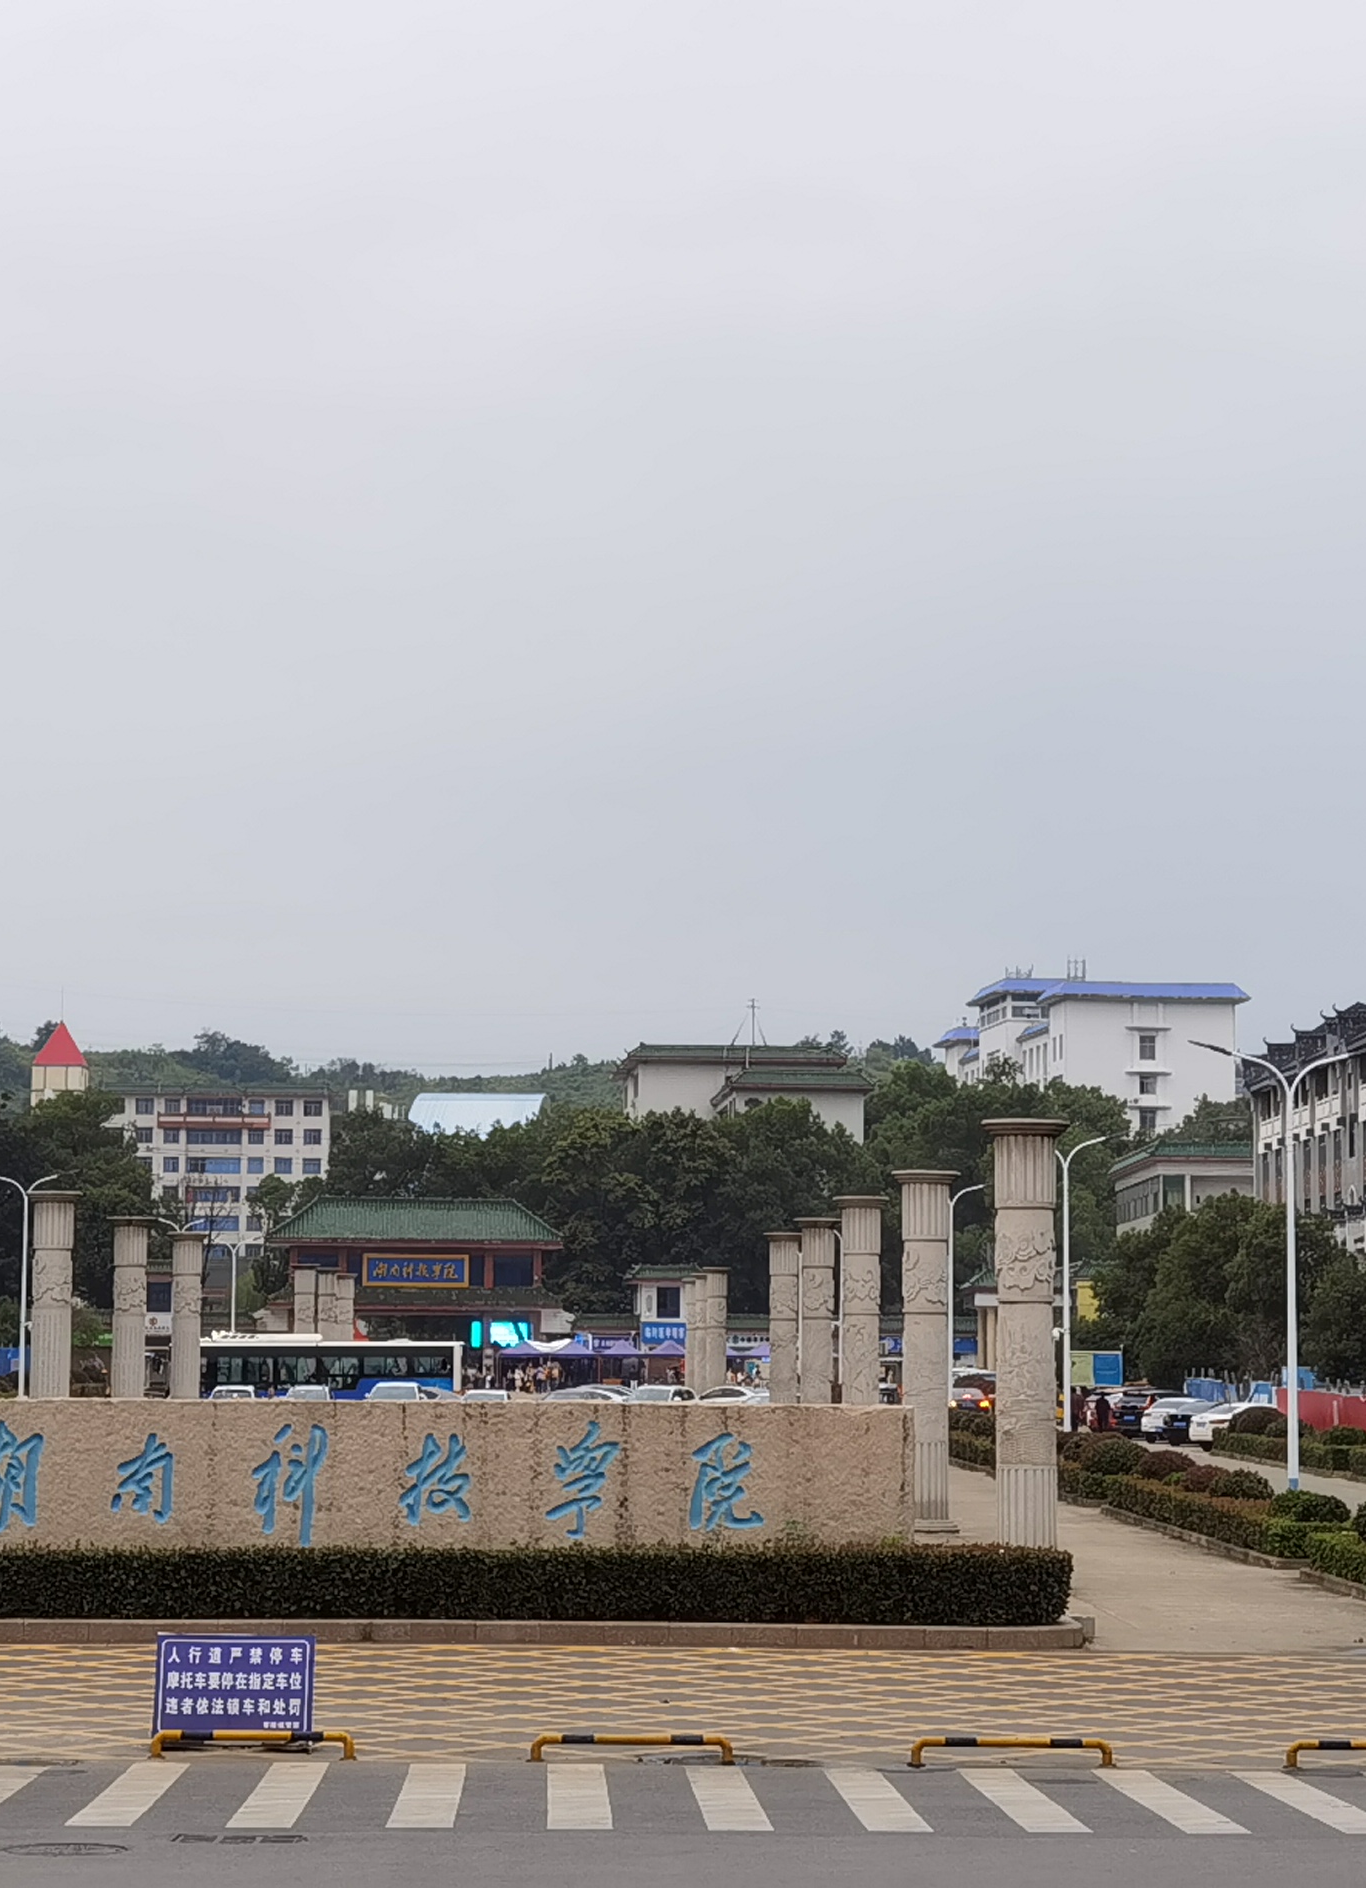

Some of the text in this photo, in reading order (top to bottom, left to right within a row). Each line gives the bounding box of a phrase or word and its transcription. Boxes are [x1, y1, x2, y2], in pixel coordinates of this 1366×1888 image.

[167, 1646, 303, 1665] 人行道严禁停车
[166, 1671, 303, 1690] 摩托车要停在指定车位
[164, 1696, 301, 1716] 违者依法锁车和处罚
